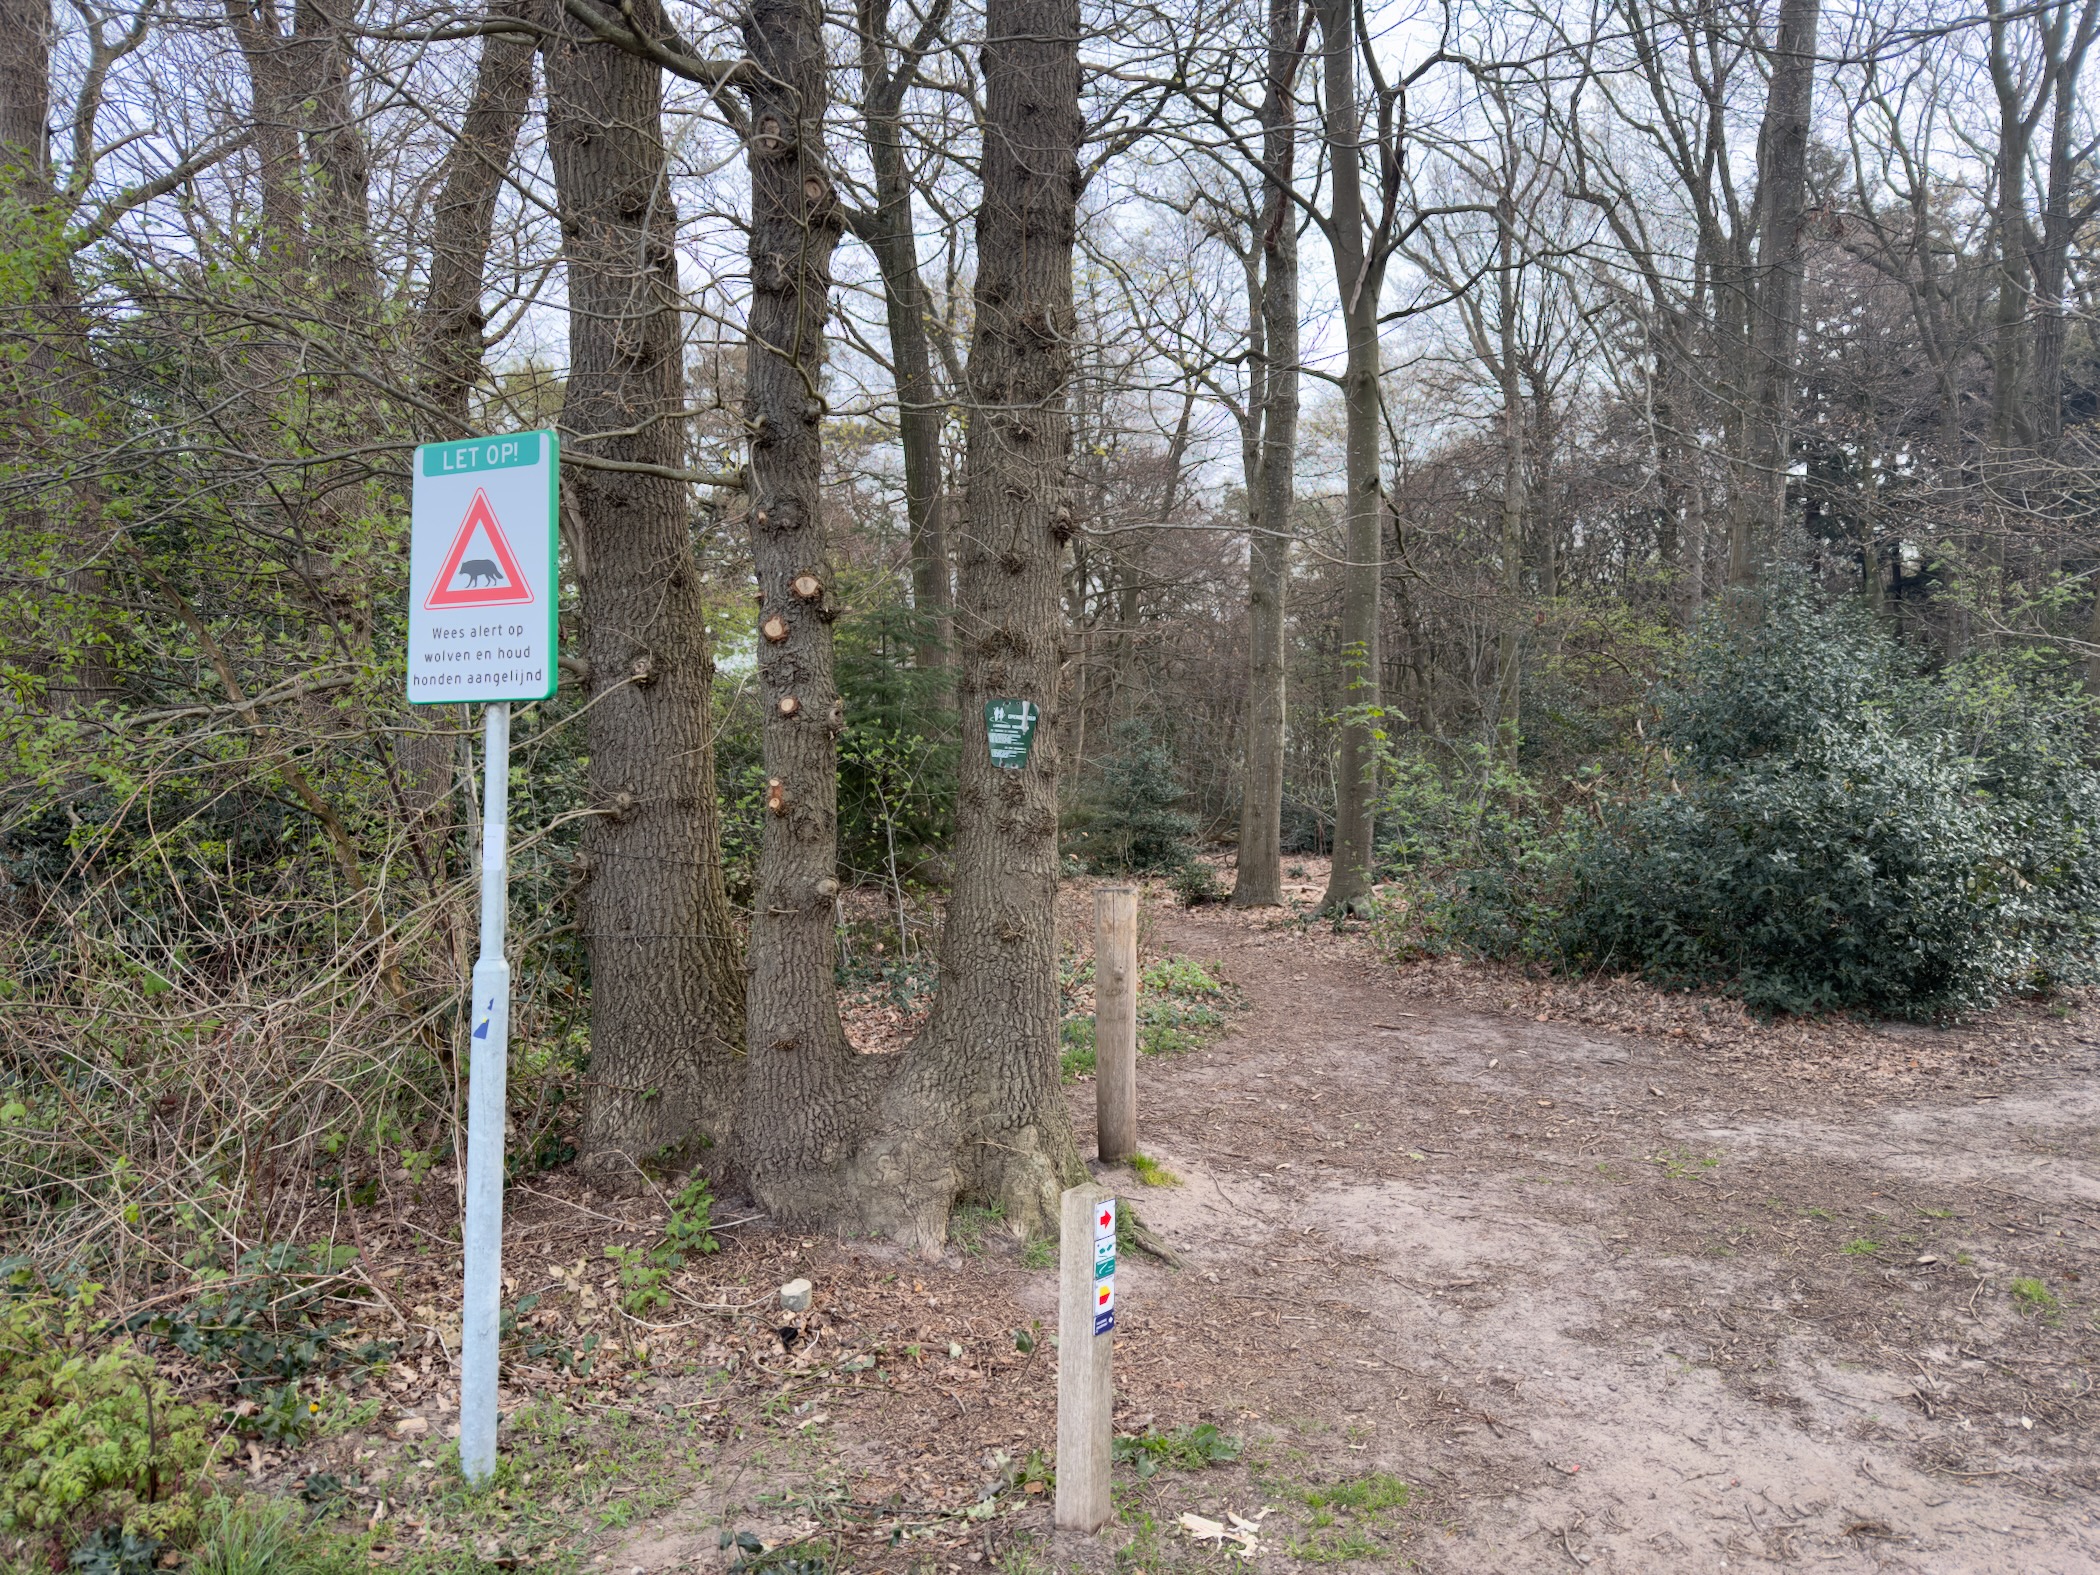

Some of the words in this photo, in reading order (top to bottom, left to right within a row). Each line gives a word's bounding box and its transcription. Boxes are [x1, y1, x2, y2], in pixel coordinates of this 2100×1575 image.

[443, 447, 479, 470] LET
[487, 442, 518, 465] OP!
[432, 628, 465, 640] Wees
[470, 624, 503, 638] alert
[508, 625, 524, 638] op
[424, 650, 470, 662] wolven
[476, 650, 492, 660] en
[498, 645, 531, 659] houd
[413, 673, 461, 686] honden
[467, 668, 542, 687] aangelijnd
